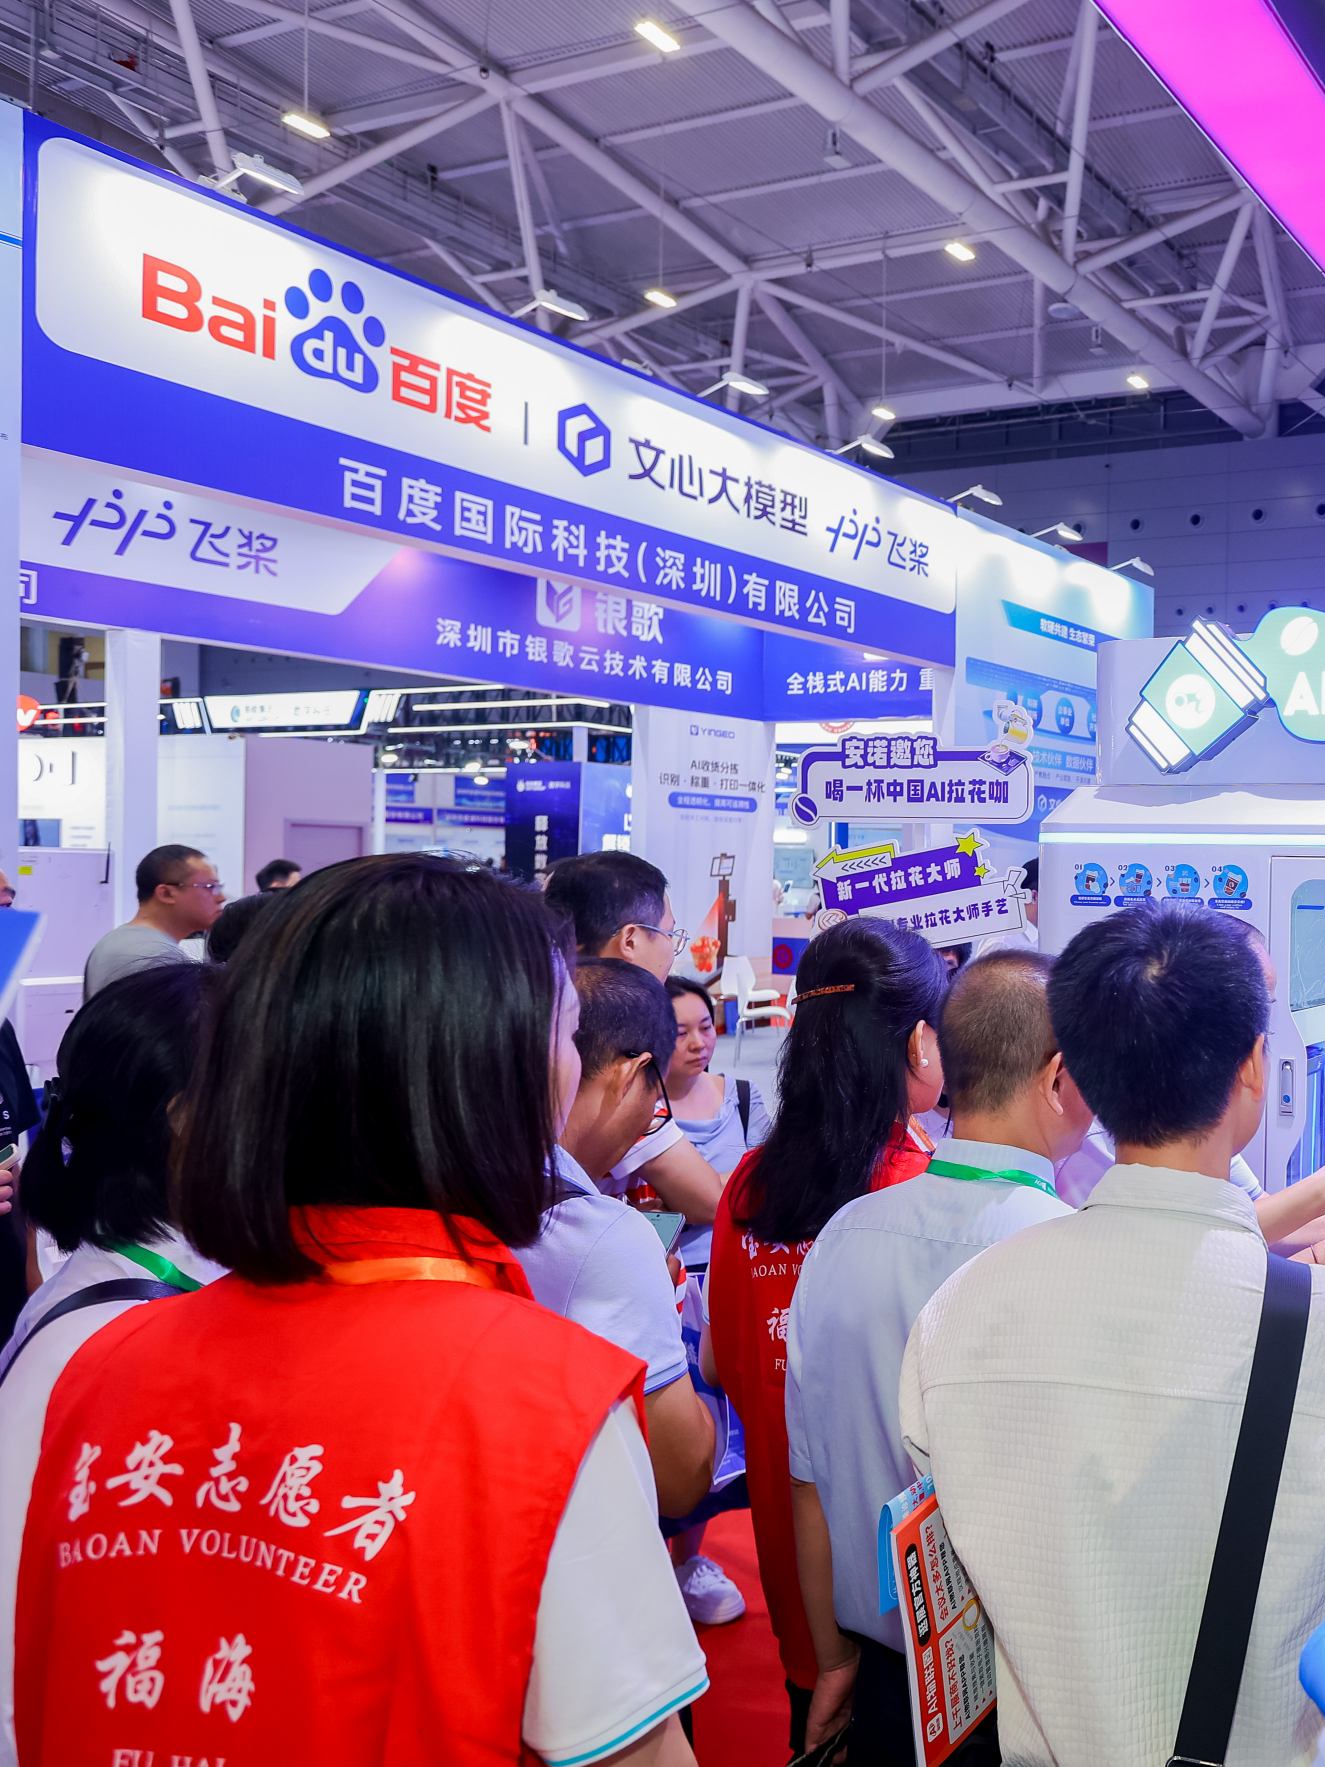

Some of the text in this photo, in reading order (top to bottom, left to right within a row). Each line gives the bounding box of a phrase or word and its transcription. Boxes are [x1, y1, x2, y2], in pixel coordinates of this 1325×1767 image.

[390, 346, 491, 433] 百度
[628, 436, 809, 537] 文心大模型
[188, 517, 279, 577] 飞桨
[886, 530, 930, 579] 飞桨
[595, 592, 664, 644] 银歌
[436, 617, 733, 695] 深圳市银歌云技术有限公司
[786, 668, 909, 695] 全栈式AI能力
[845, 738, 934, 768] 安诺邀您
[824, 778, 1010, 804] 喝一杯中国AI拉花咖
[836, 857, 962, 902] 新一代拉花大师
[892, 897, 1009, 931] 专业拉花大师手艺
[58, 1528, 368, 1604] BAOAN VOLUNTEER
[906, 1550, 931, 1639] 逛展官方神器
